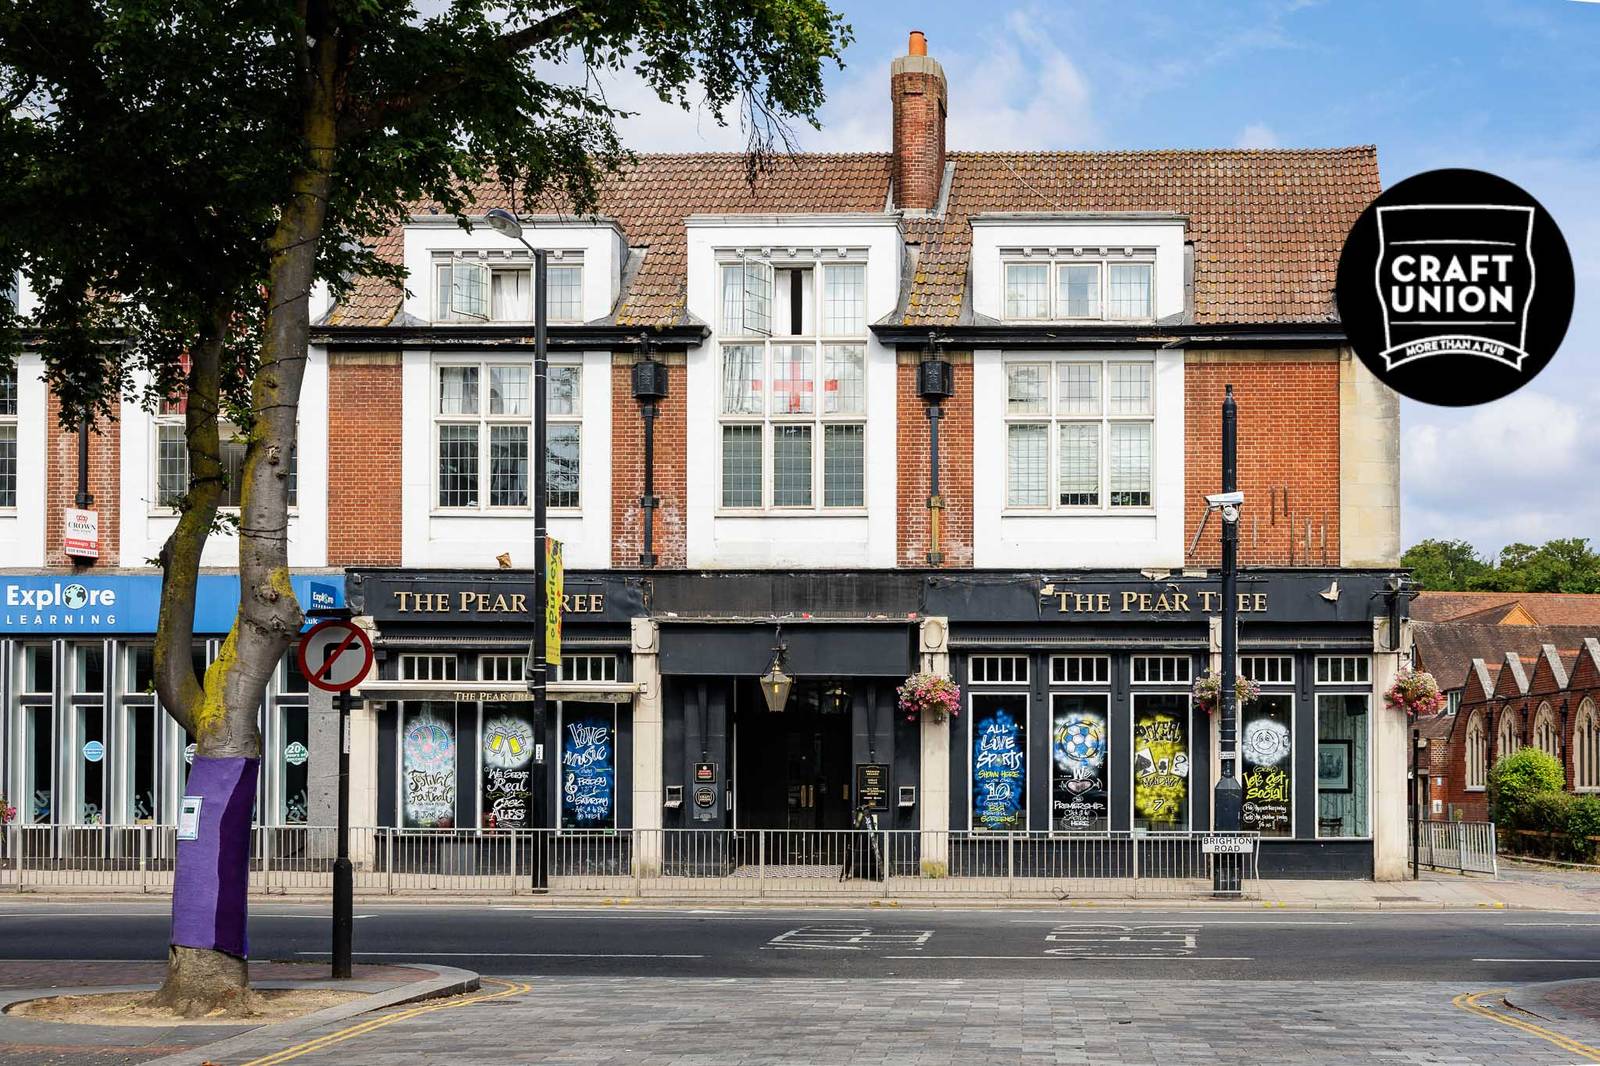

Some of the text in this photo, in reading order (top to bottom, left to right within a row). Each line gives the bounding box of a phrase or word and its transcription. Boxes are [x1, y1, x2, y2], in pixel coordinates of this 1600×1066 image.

[394, 591, 450, 613] THE
[458, 591, 528, 613] PEAR
[1054, 591, 1111, 613] THE
[1120, 591, 1191, 613] PEAR
[6, 615, 116, 625] LEARNING
[454, 691, 476, 701] THE
[480, 692, 507, 701] PEAR
[987, 724, 1009, 734] ALL
[1203, 837, 1252, 845] BRIGHTON
